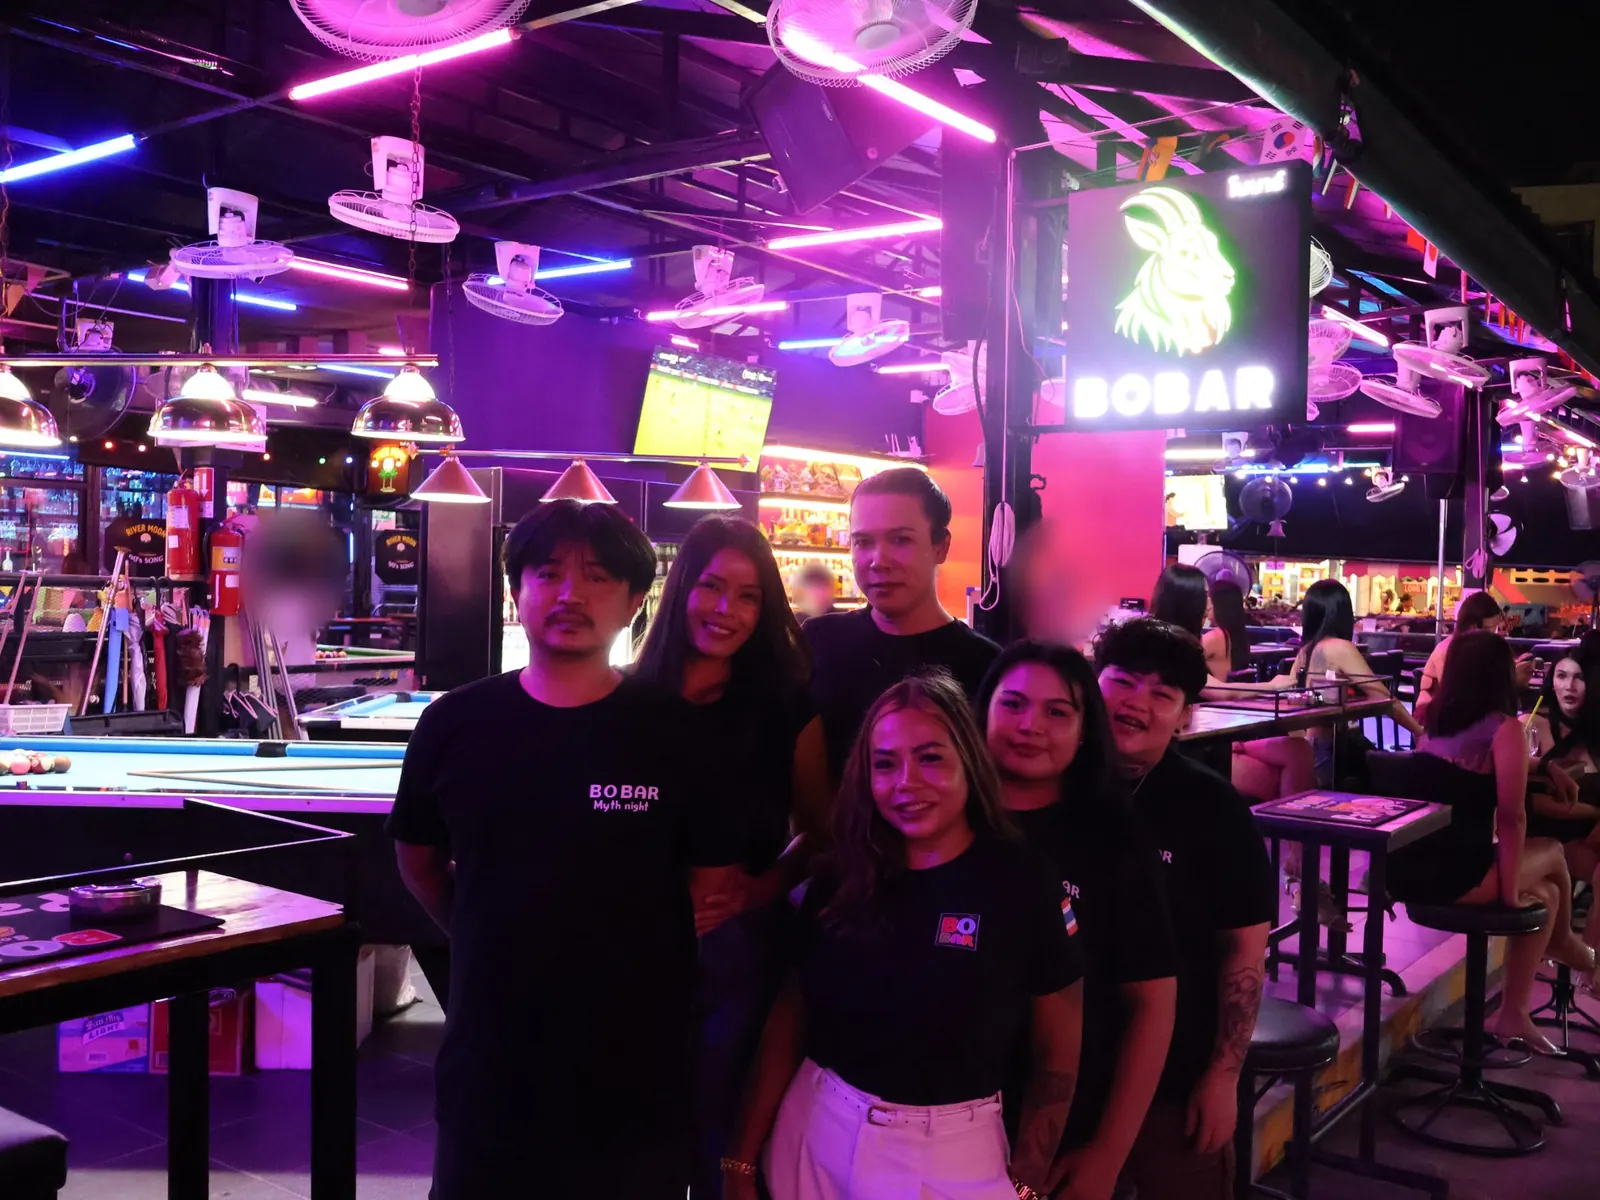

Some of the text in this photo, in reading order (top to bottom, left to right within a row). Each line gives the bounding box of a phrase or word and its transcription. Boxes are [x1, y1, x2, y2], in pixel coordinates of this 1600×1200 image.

[1073, 366, 1275, 419] BOBAR
[125, 523, 146, 537] RIVER
[144, 554, 164, 564] SONG
[593, 799, 650, 813] Myth night
[942, 917, 977, 935] BO
[87, 1022, 120, 1040] LIGHT
